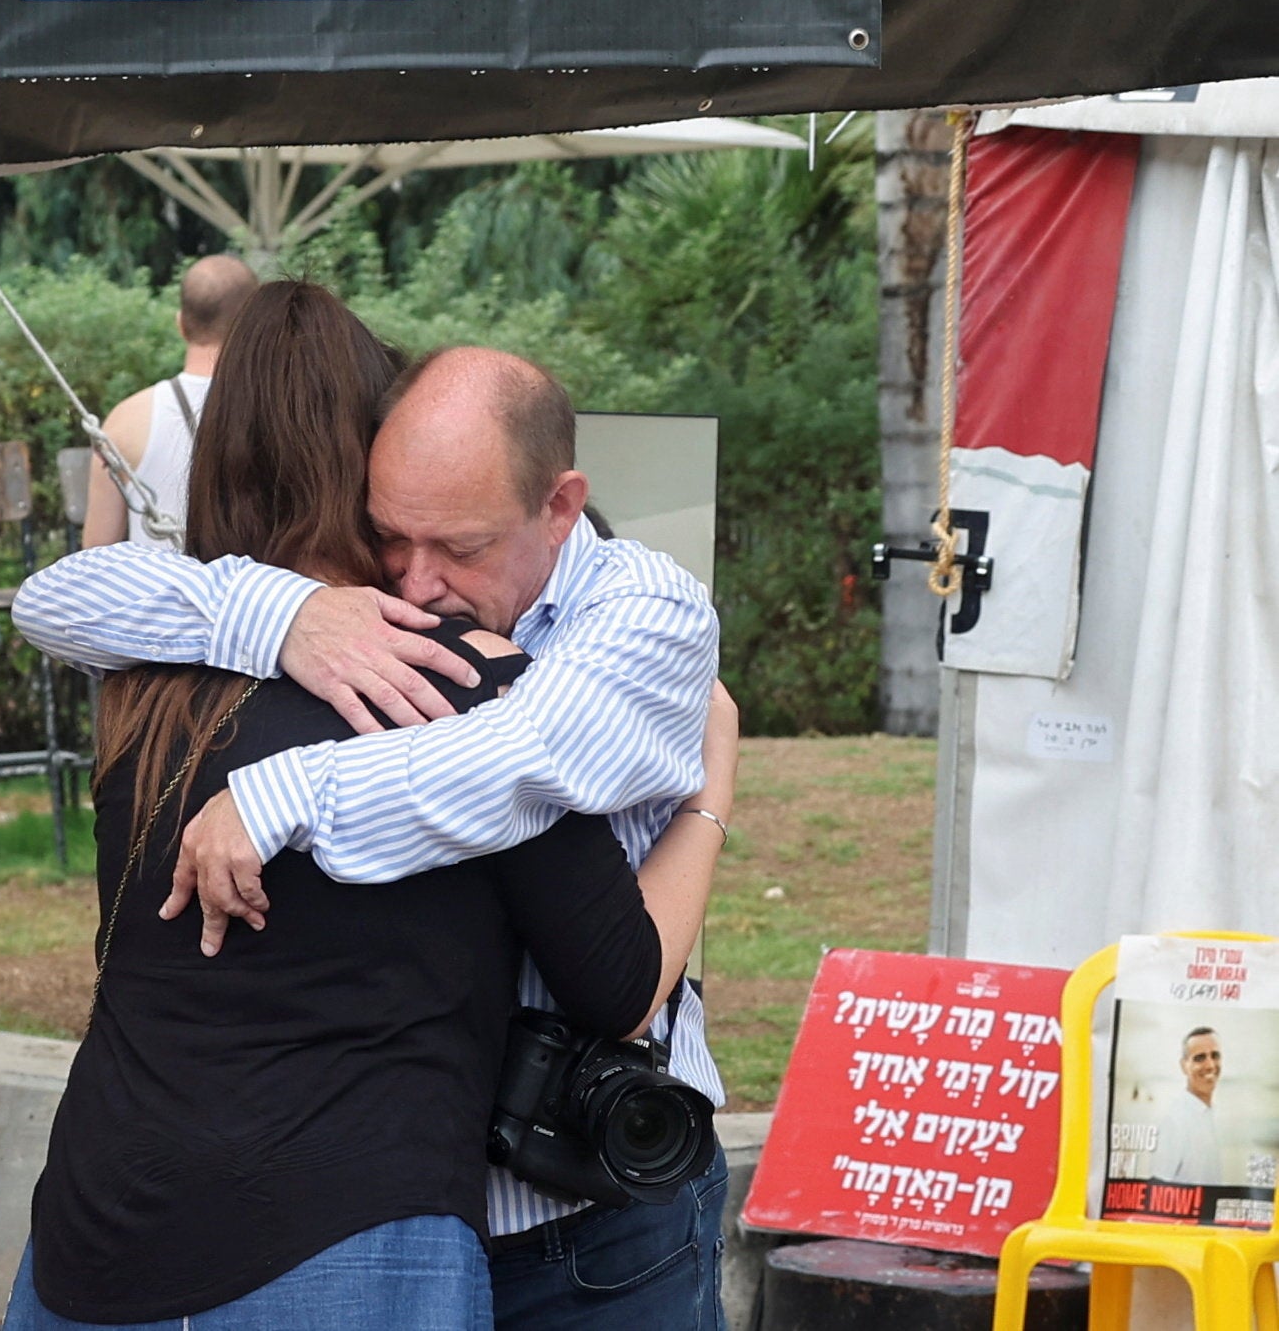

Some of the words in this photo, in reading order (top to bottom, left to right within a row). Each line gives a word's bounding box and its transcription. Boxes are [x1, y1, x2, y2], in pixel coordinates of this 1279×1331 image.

[1111, 1123, 1159, 1152] BRING
[1106, 1182, 1147, 1210] HOME
[1149, 1184, 1204, 1216] NOW!
